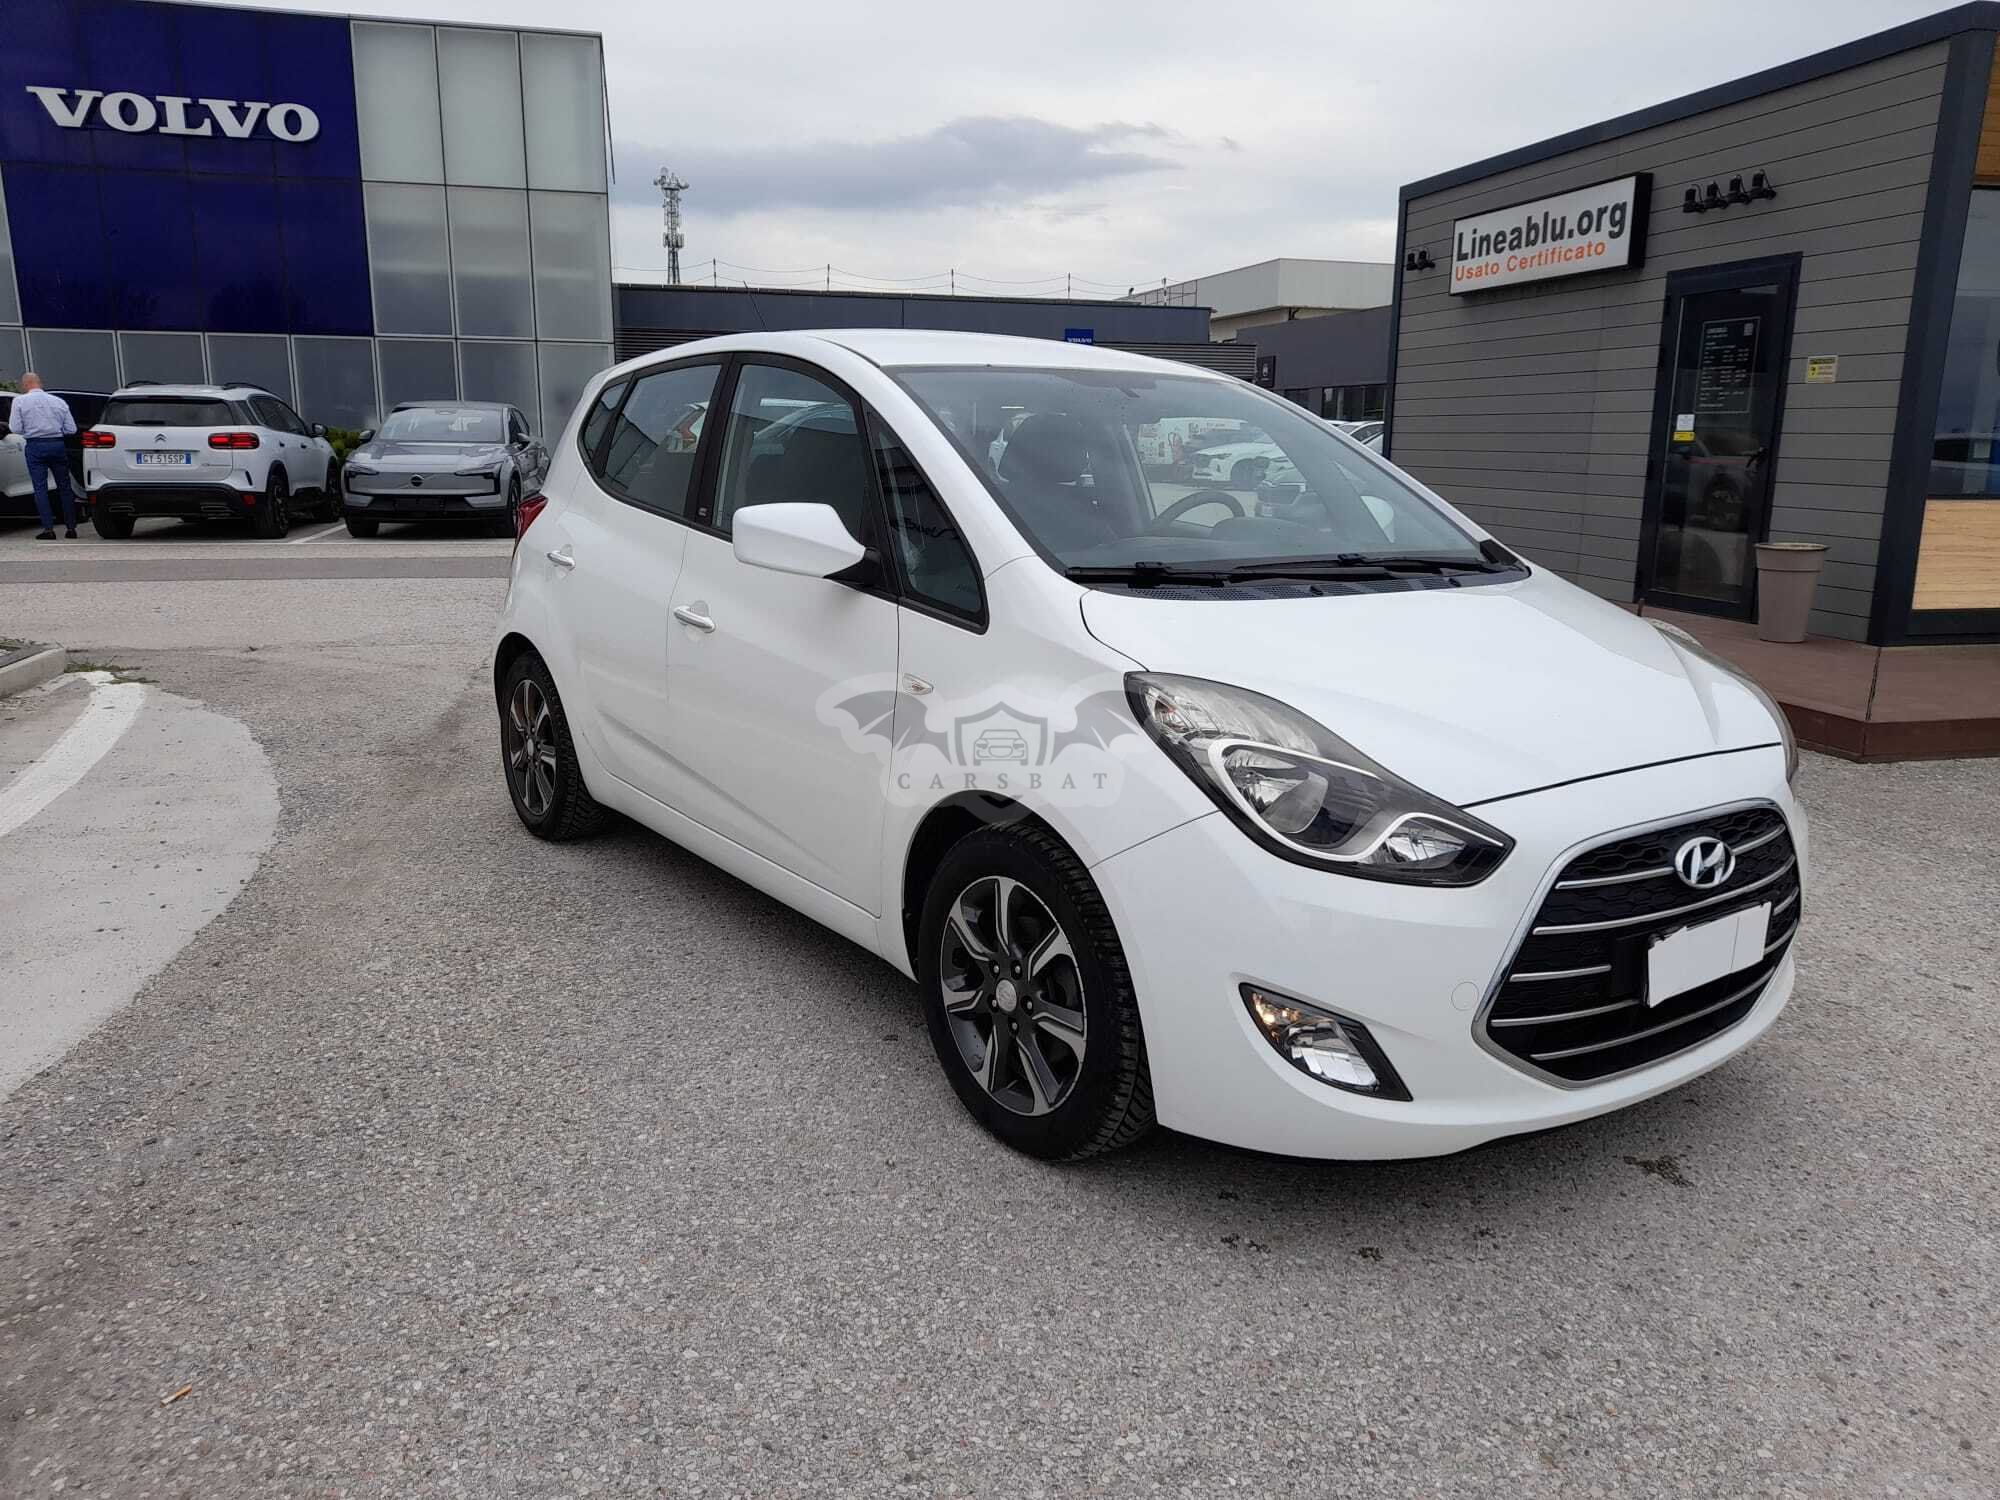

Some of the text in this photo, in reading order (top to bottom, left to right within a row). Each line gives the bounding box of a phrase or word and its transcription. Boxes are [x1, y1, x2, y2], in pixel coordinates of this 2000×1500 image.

[25, 85, 320, 142] VOLVO
[1456, 201, 1628, 262] Lineablu.org
[1455, 240, 1606, 281] Usato Certificato
